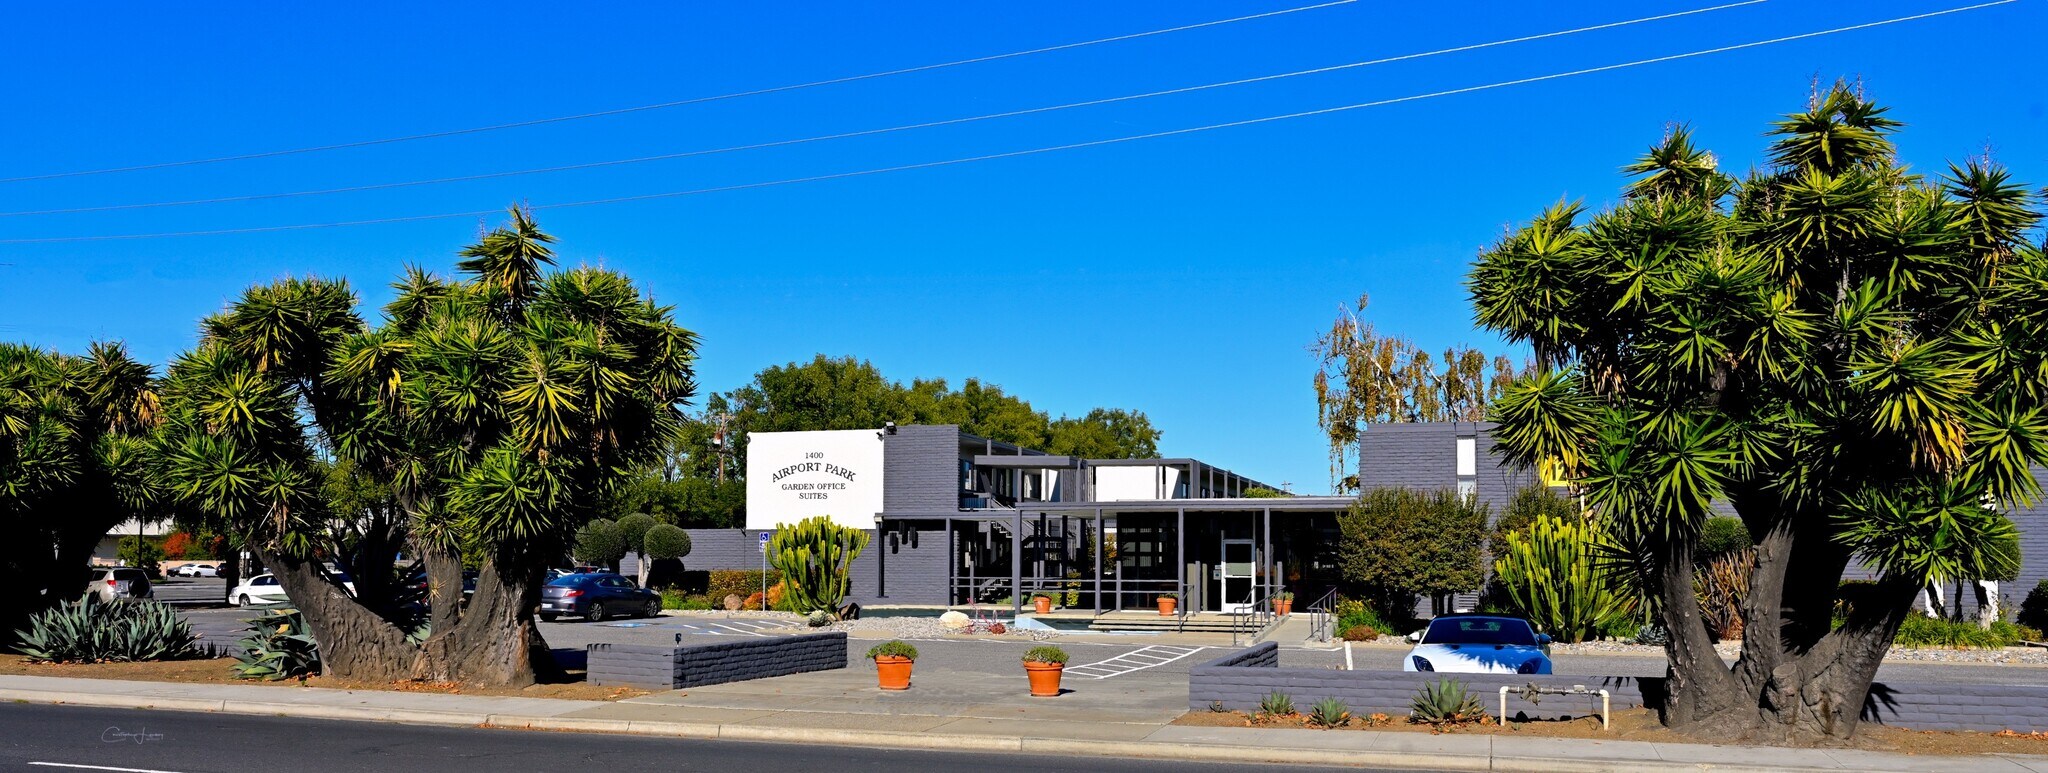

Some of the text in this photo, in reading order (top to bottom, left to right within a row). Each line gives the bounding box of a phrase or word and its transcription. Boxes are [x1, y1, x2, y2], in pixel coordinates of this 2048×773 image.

[772, 462, 857, 483] AIRPORT PARK
[781, 483, 815, 491] GARDEN
[798, 492, 828, 500] SUITES
